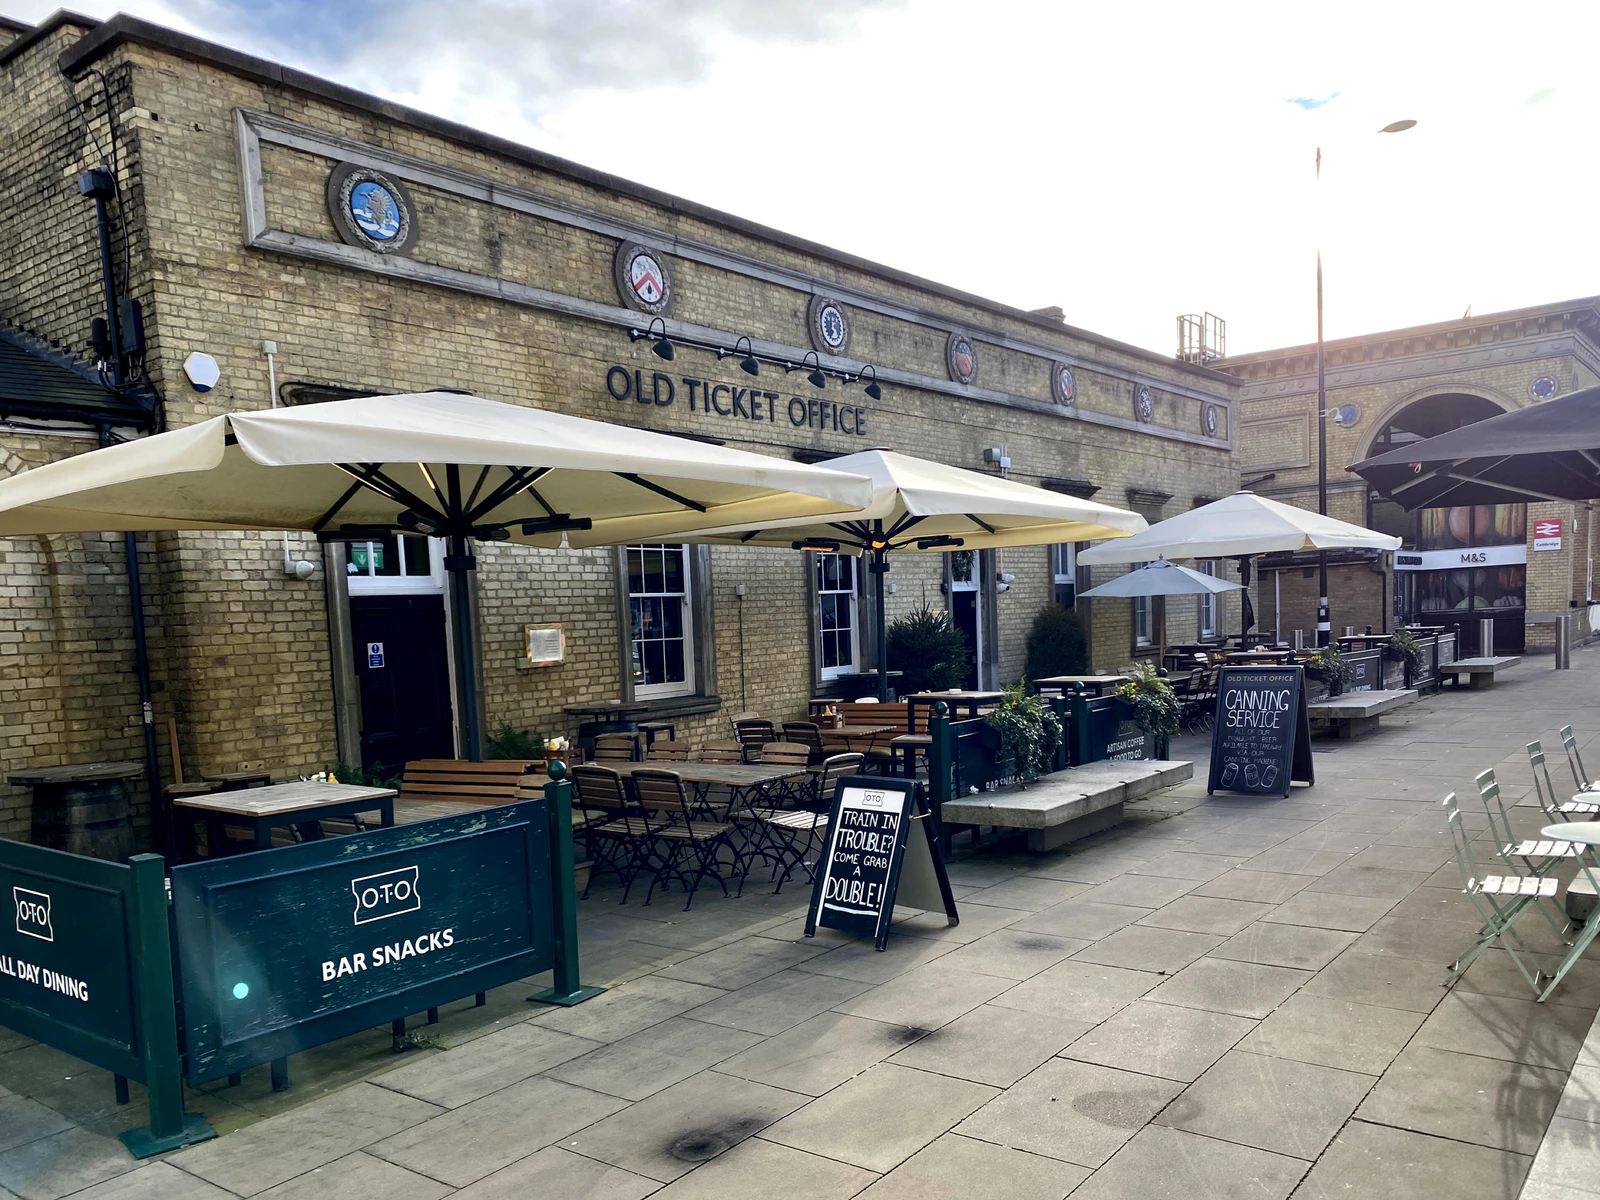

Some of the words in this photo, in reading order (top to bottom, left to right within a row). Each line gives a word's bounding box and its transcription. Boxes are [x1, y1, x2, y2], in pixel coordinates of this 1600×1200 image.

[606, 366, 675, 406] OLD
[683, 378, 779, 422] TICKET
[788, 397, 867, 435] OFFICE
[1460, 552, 1487, 563] M&S
[1225, 689, 1290, 711] CANNING
[1226, 710, 1282, 728] SERVICE
[1106, 740, 1127, 754] ARTISAN
[1127, 736, 1145, 748] COFFEE
[1134, 749, 1142, 758] GO
[1259, 743, 1283, 751] TAKEAWAY
[844, 811, 879, 828] TRAIN
[882, 815, 898, 829] IN
[839, 829, 893, 853] TROUBLE?
[834, 851, 859, 865] COME
[864, 855, 887, 868] GRAB
[853, 866, 861, 877] A
[825, 877, 882, 907] DOUBLE!
[321, 952, 367, 982] BAR
[372, 928, 454, 967] SNACKS
[17, 960, 40, 985] DAY
[42, 968, 89, 1002] DINING
